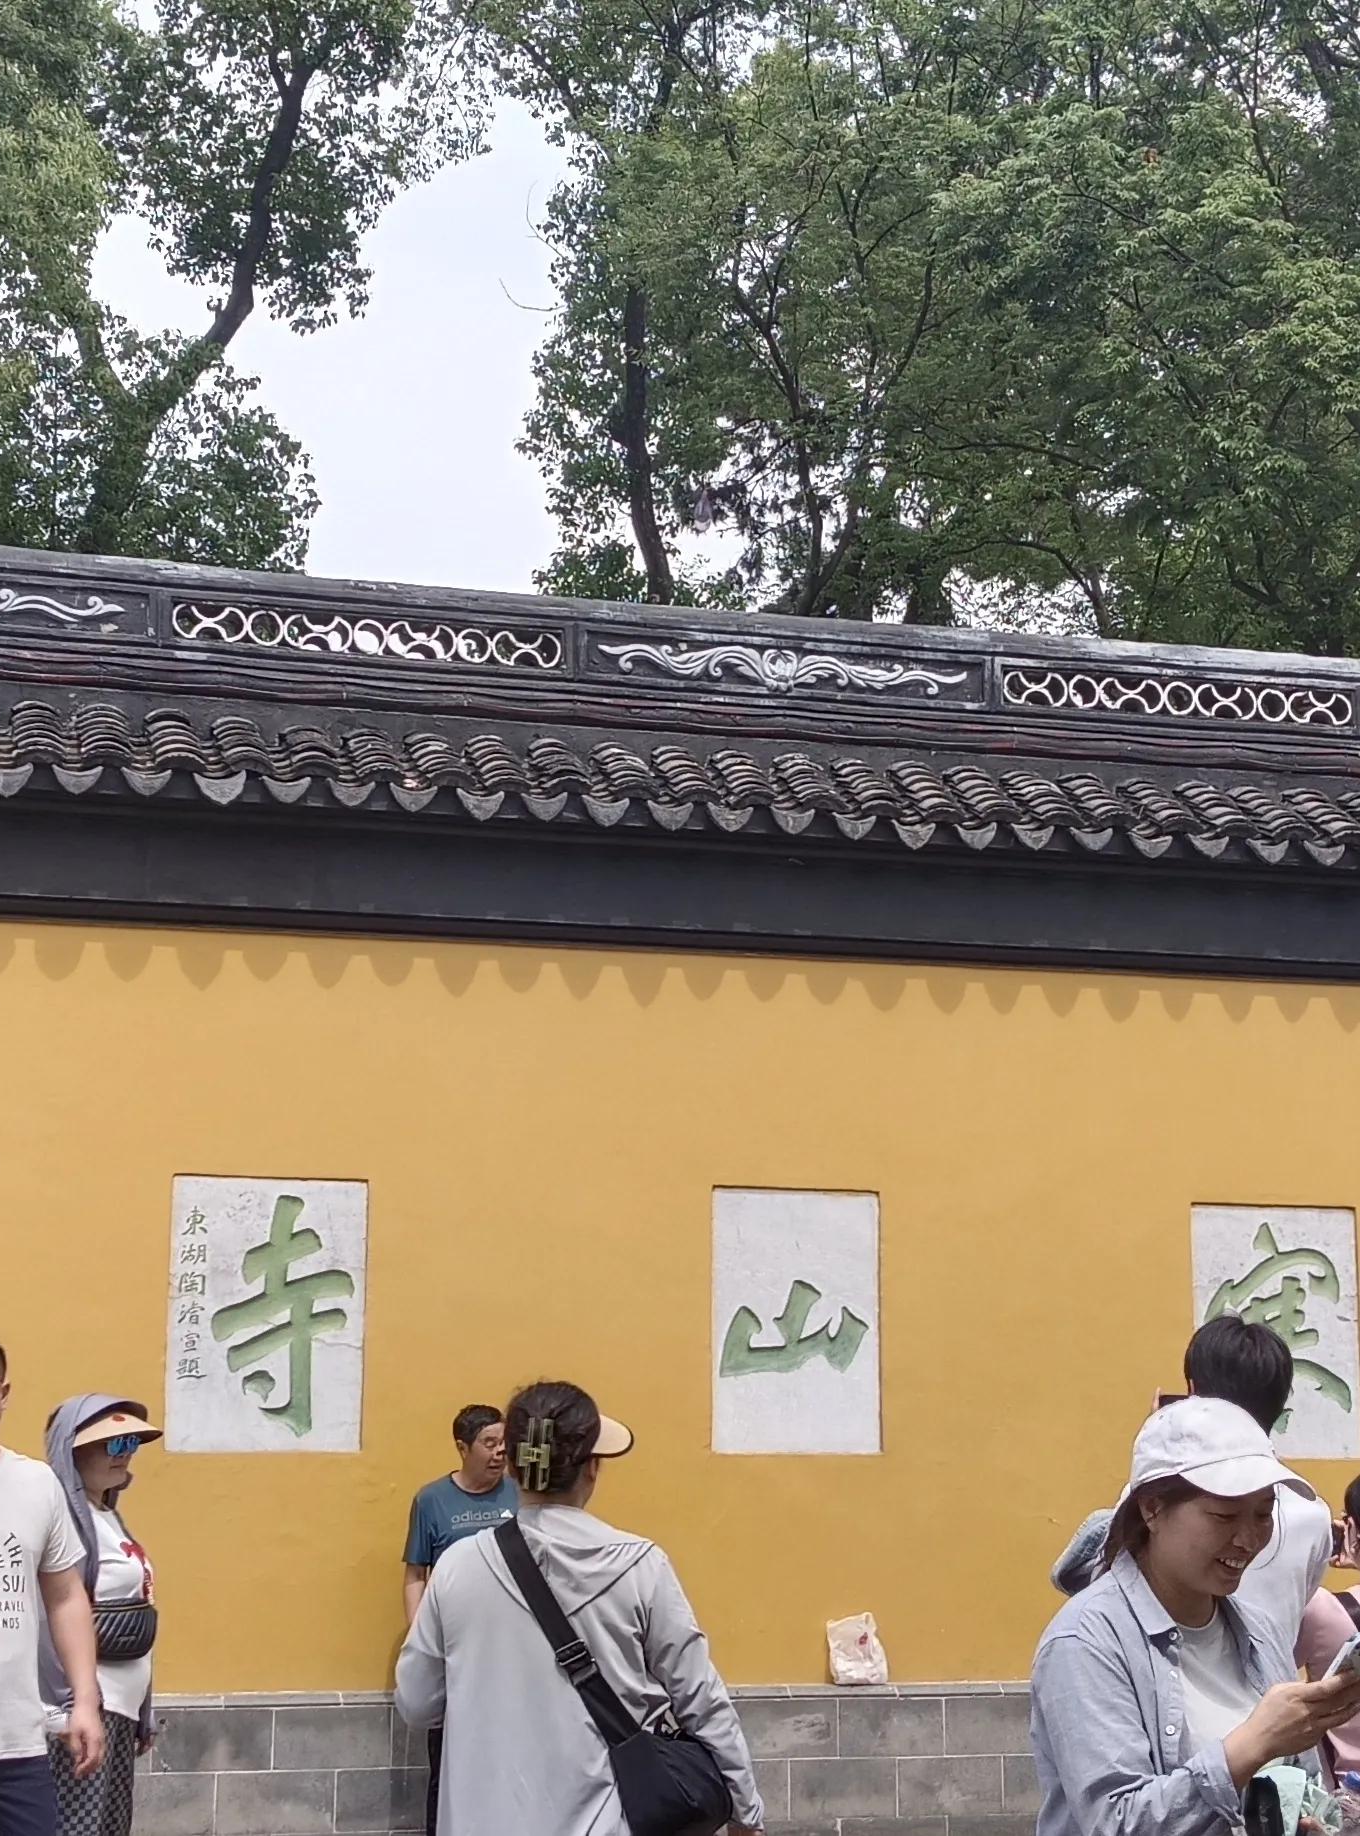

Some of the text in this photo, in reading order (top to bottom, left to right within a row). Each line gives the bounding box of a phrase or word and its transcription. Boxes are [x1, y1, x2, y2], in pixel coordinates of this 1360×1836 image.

[210, 1193, 355, 1438] 寺
[718, 1279, 869, 1378] 山
[3, 1532, 23, 1569] THE
[451, 1510, 499, 1523] adidas
